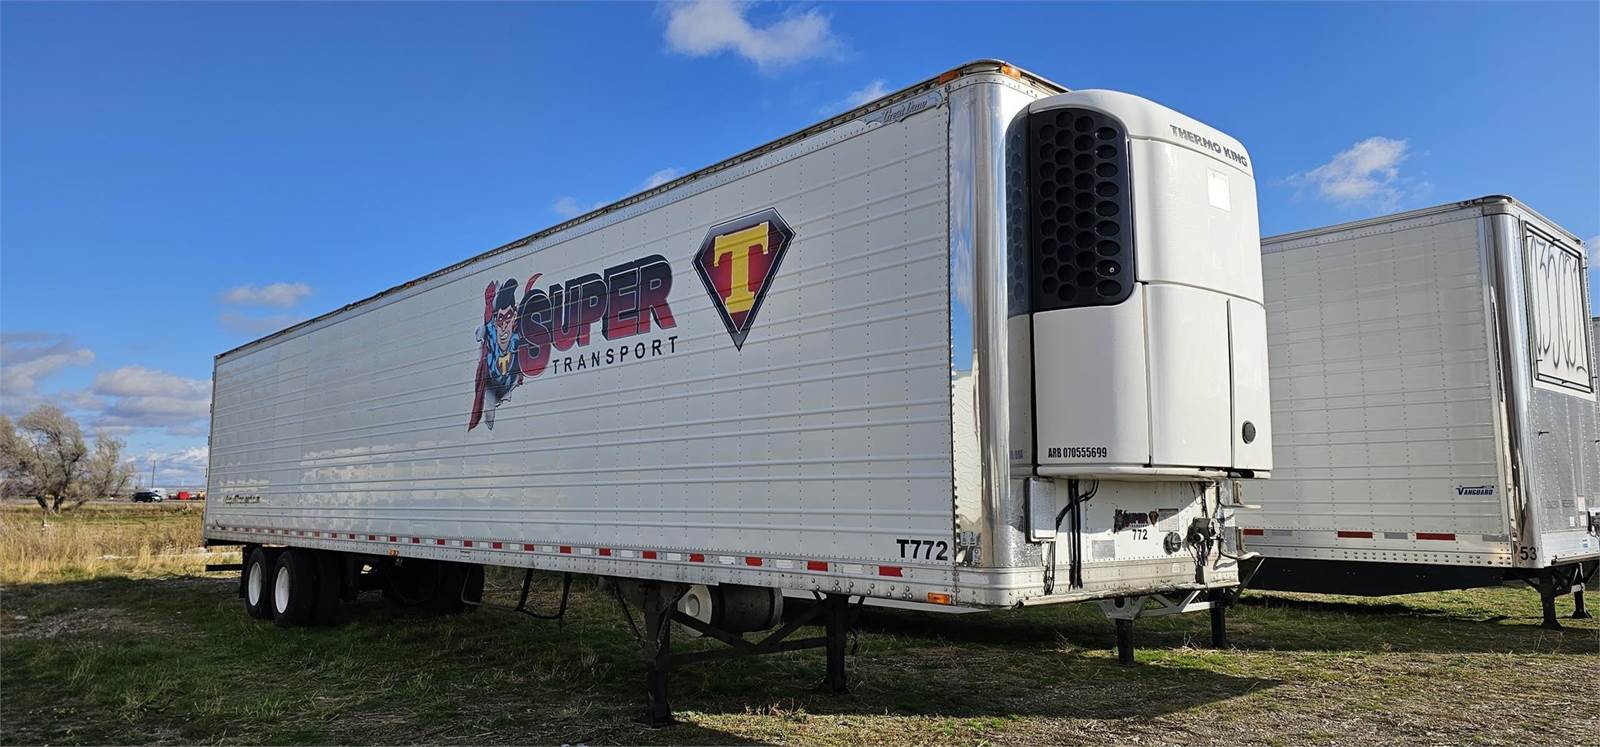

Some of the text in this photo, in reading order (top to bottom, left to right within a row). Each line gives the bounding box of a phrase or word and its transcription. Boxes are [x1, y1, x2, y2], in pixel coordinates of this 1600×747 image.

[1169, 124, 1248, 168] THERMO KING
[713, 221, 770, 314] T
[517, 254, 677, 379] SUPER
[552, 335, 678, 375] TRANSPORT
[1047, 446, 1108, 459] ARB 070555699
[896, 538, 949, 561] T772
[1132, 529, 1148, 541] 772
